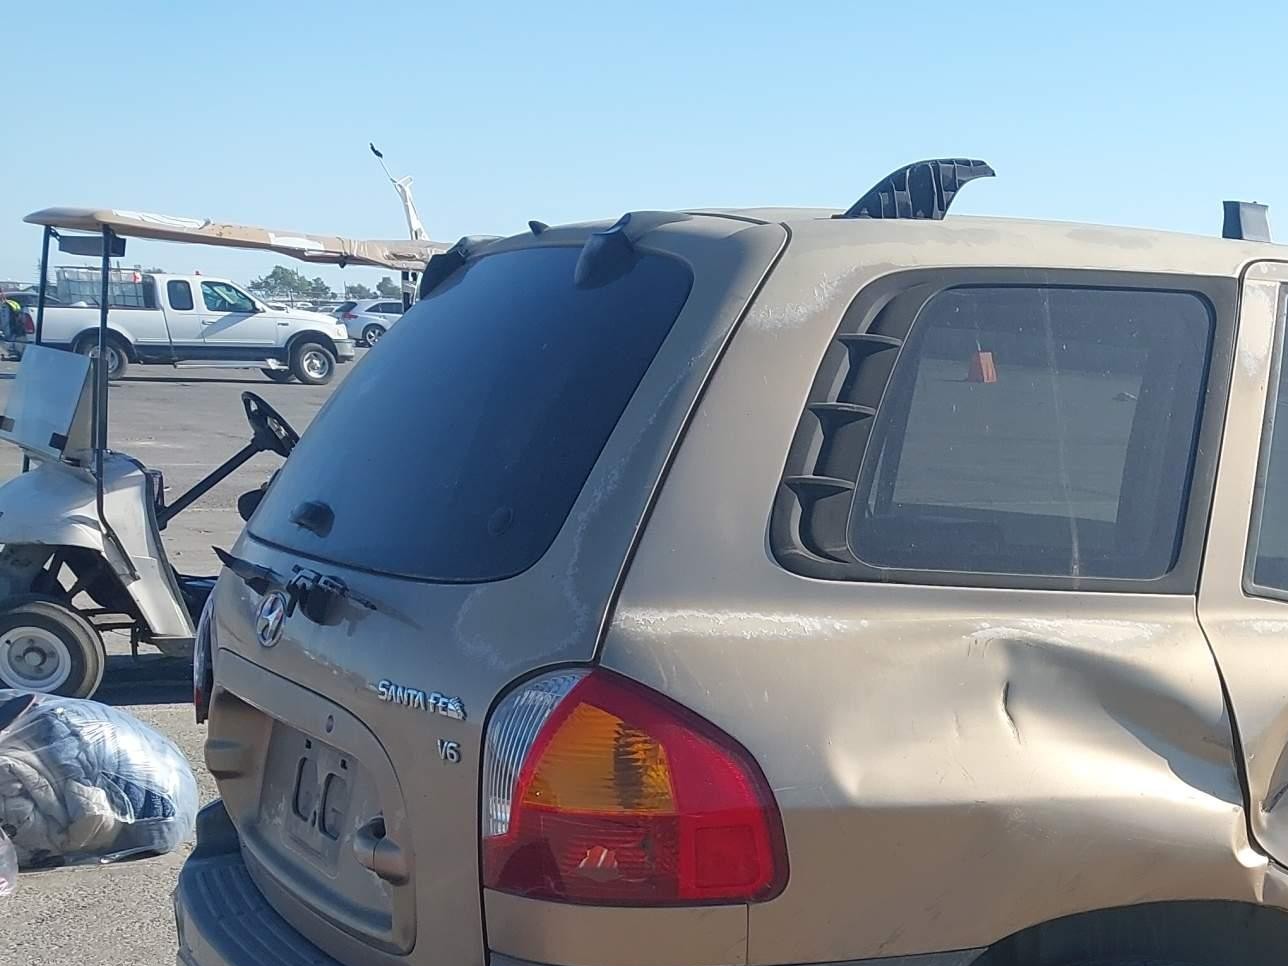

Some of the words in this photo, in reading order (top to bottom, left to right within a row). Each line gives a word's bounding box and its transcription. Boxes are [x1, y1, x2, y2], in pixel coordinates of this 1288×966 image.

[378, 680, 426, 711] SANTA
[428, 692, 449, 717] FE
[437, 739, 461, 763] V6
